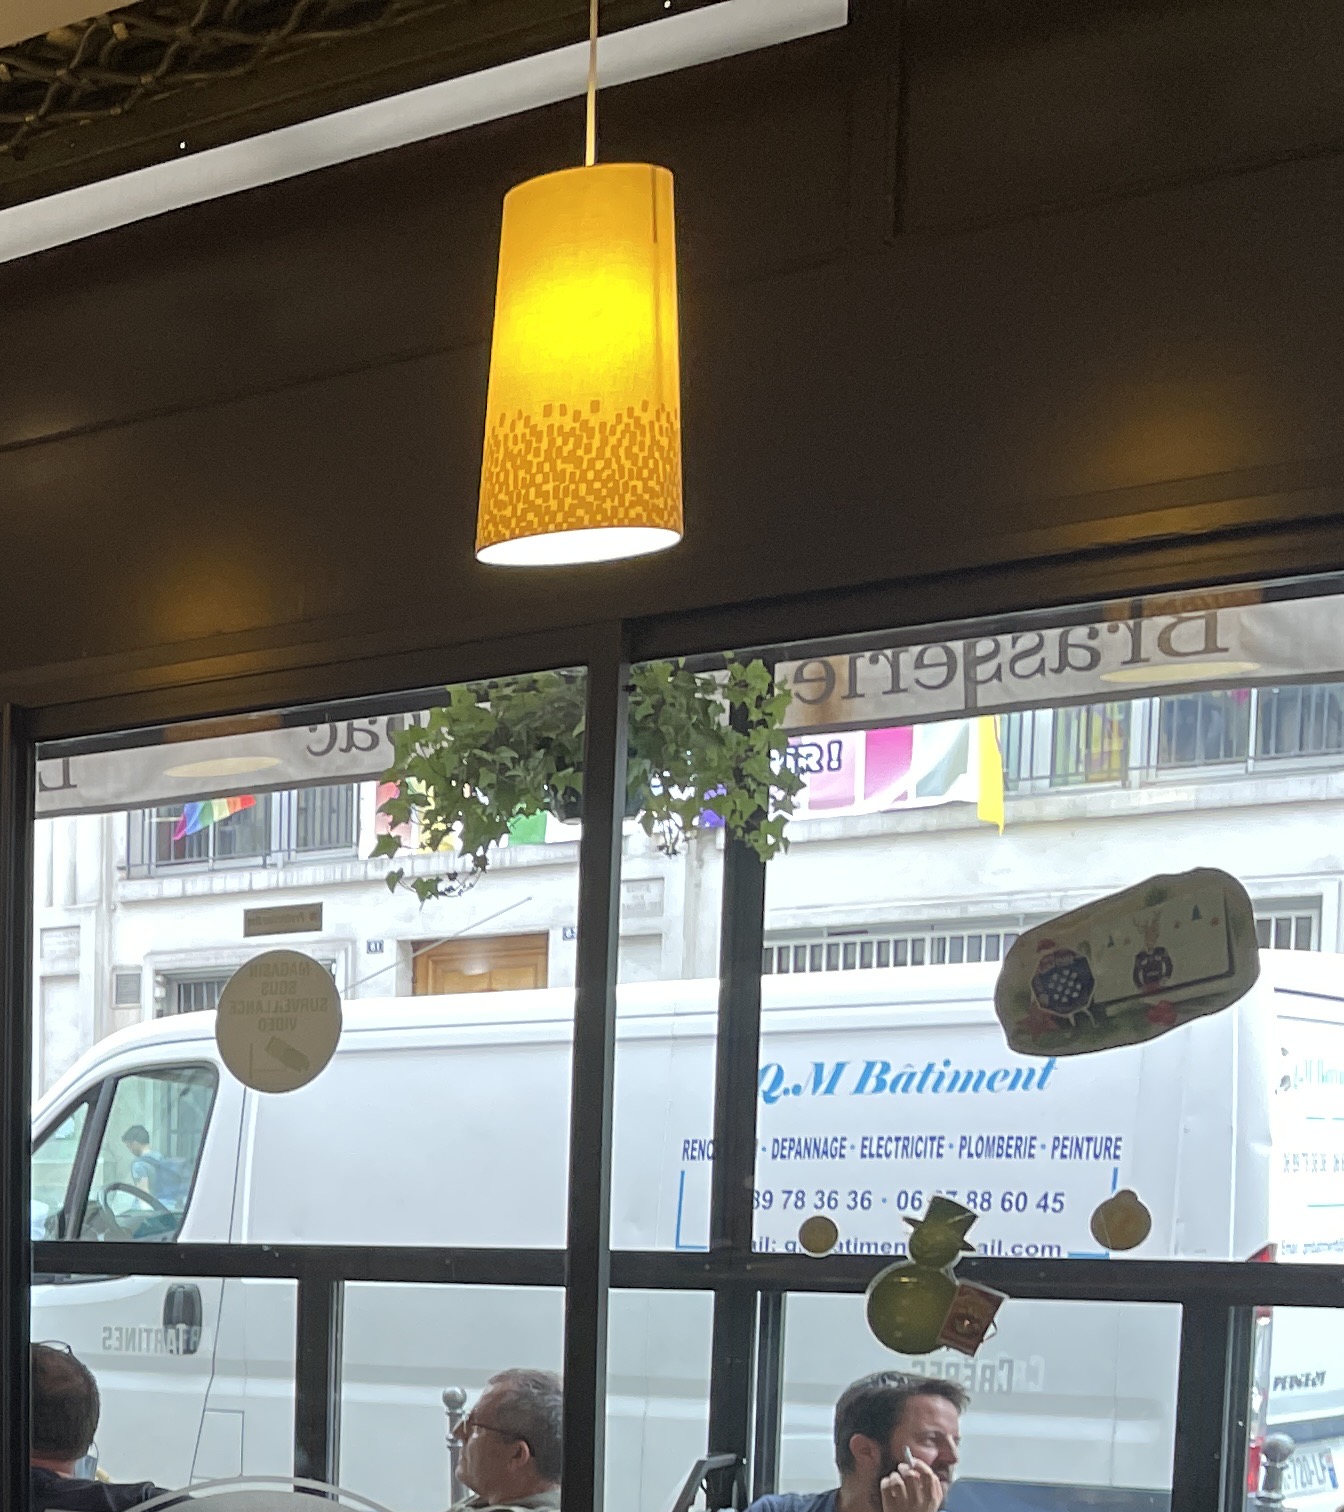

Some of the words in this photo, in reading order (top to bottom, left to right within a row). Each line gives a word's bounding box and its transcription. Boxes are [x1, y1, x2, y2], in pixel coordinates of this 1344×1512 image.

[770, 1136, 847, 1161] DEPANNAGE
[859, 1135, 946, 1160] ELECTRICITE
[957, 1136, 1038, 1160] PLOMBERIE
[1050, 1136, 1124, 1161] PEINTURE
[782, 1190, 806, 1211] 78
[814, 1190, 839, 1211] 36
[846, 1190, 872, 1211] 36
[896, 1190, 923, 1211] 06
[1000, 1191, 1028, 1213] 60
[1036, 1192, 1065, 1213] 45
